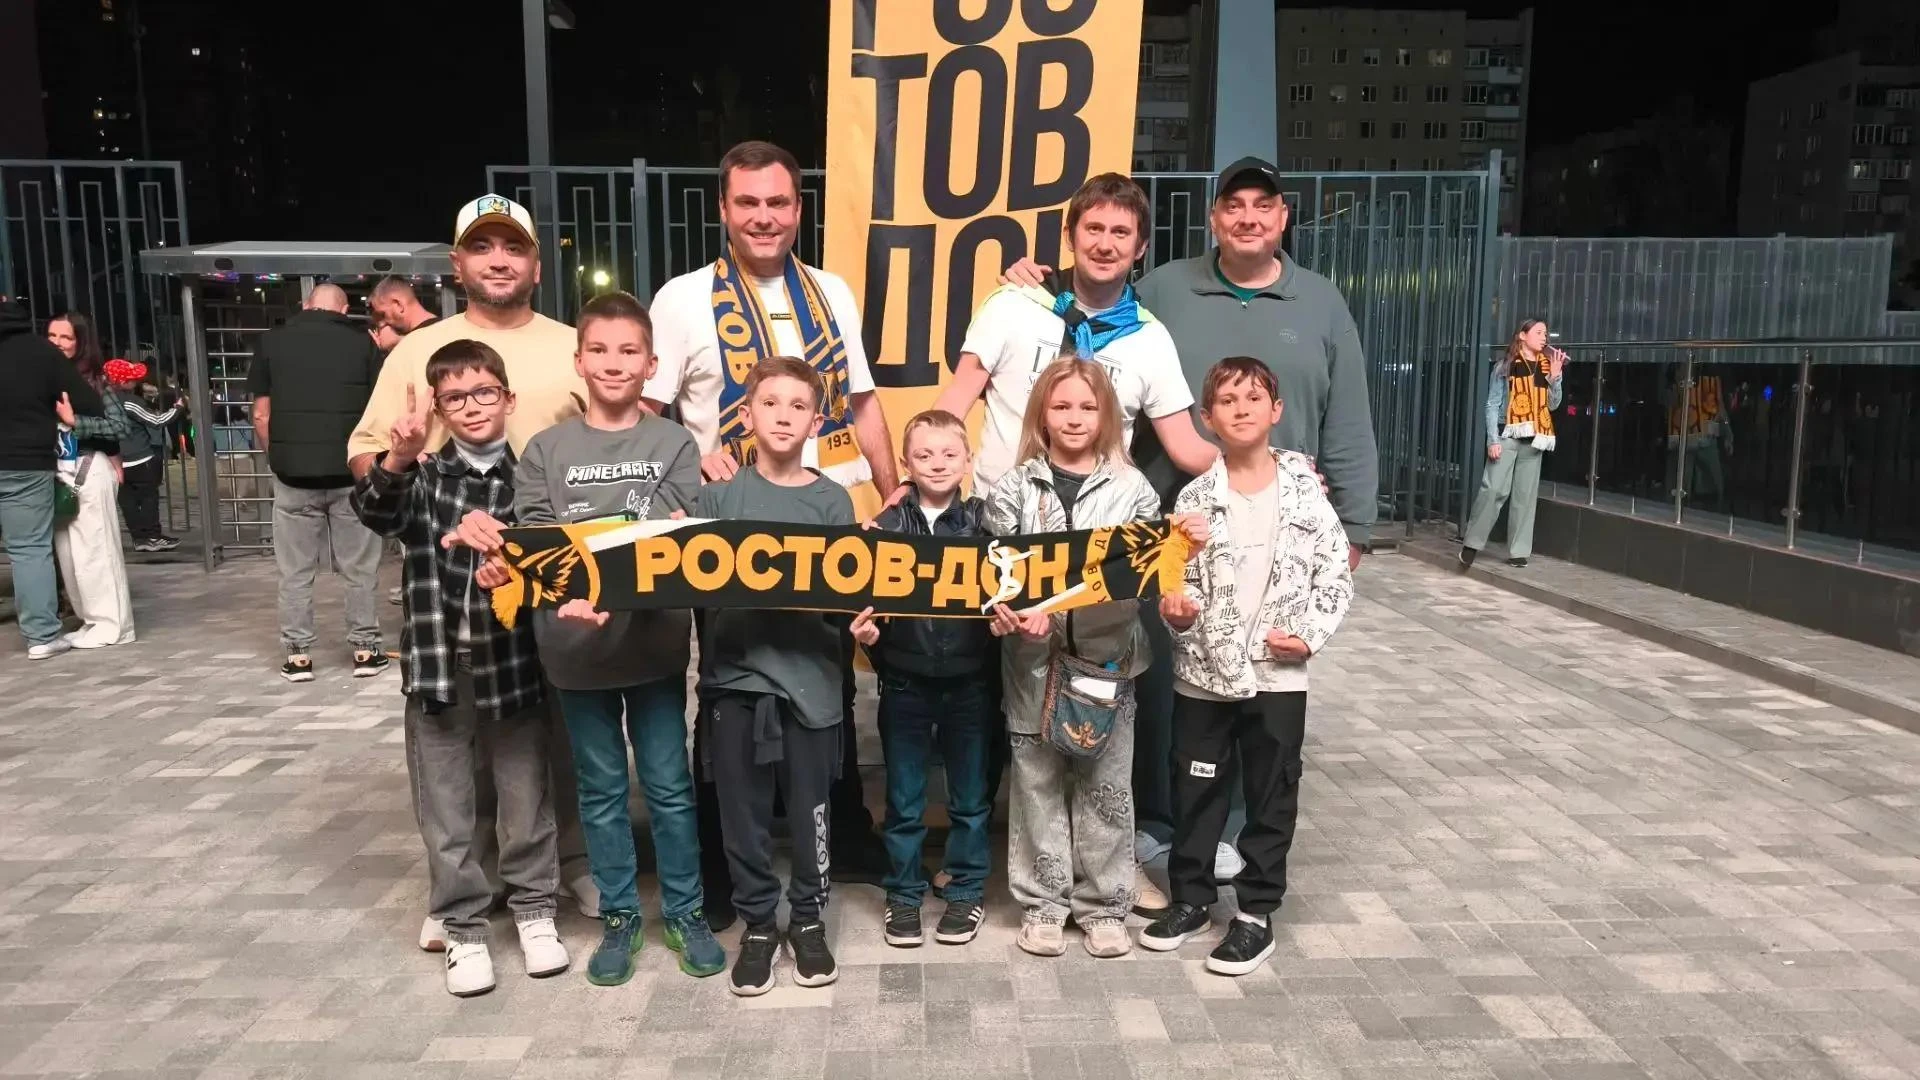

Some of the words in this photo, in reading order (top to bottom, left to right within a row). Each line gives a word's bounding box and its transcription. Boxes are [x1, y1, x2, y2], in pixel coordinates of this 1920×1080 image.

[851, 37, 1094, 221] ТОВ
[566, 461, 662, 486] MINECRAFT
[636, 533, 1069, 608] РОСТОВ-ДОН
